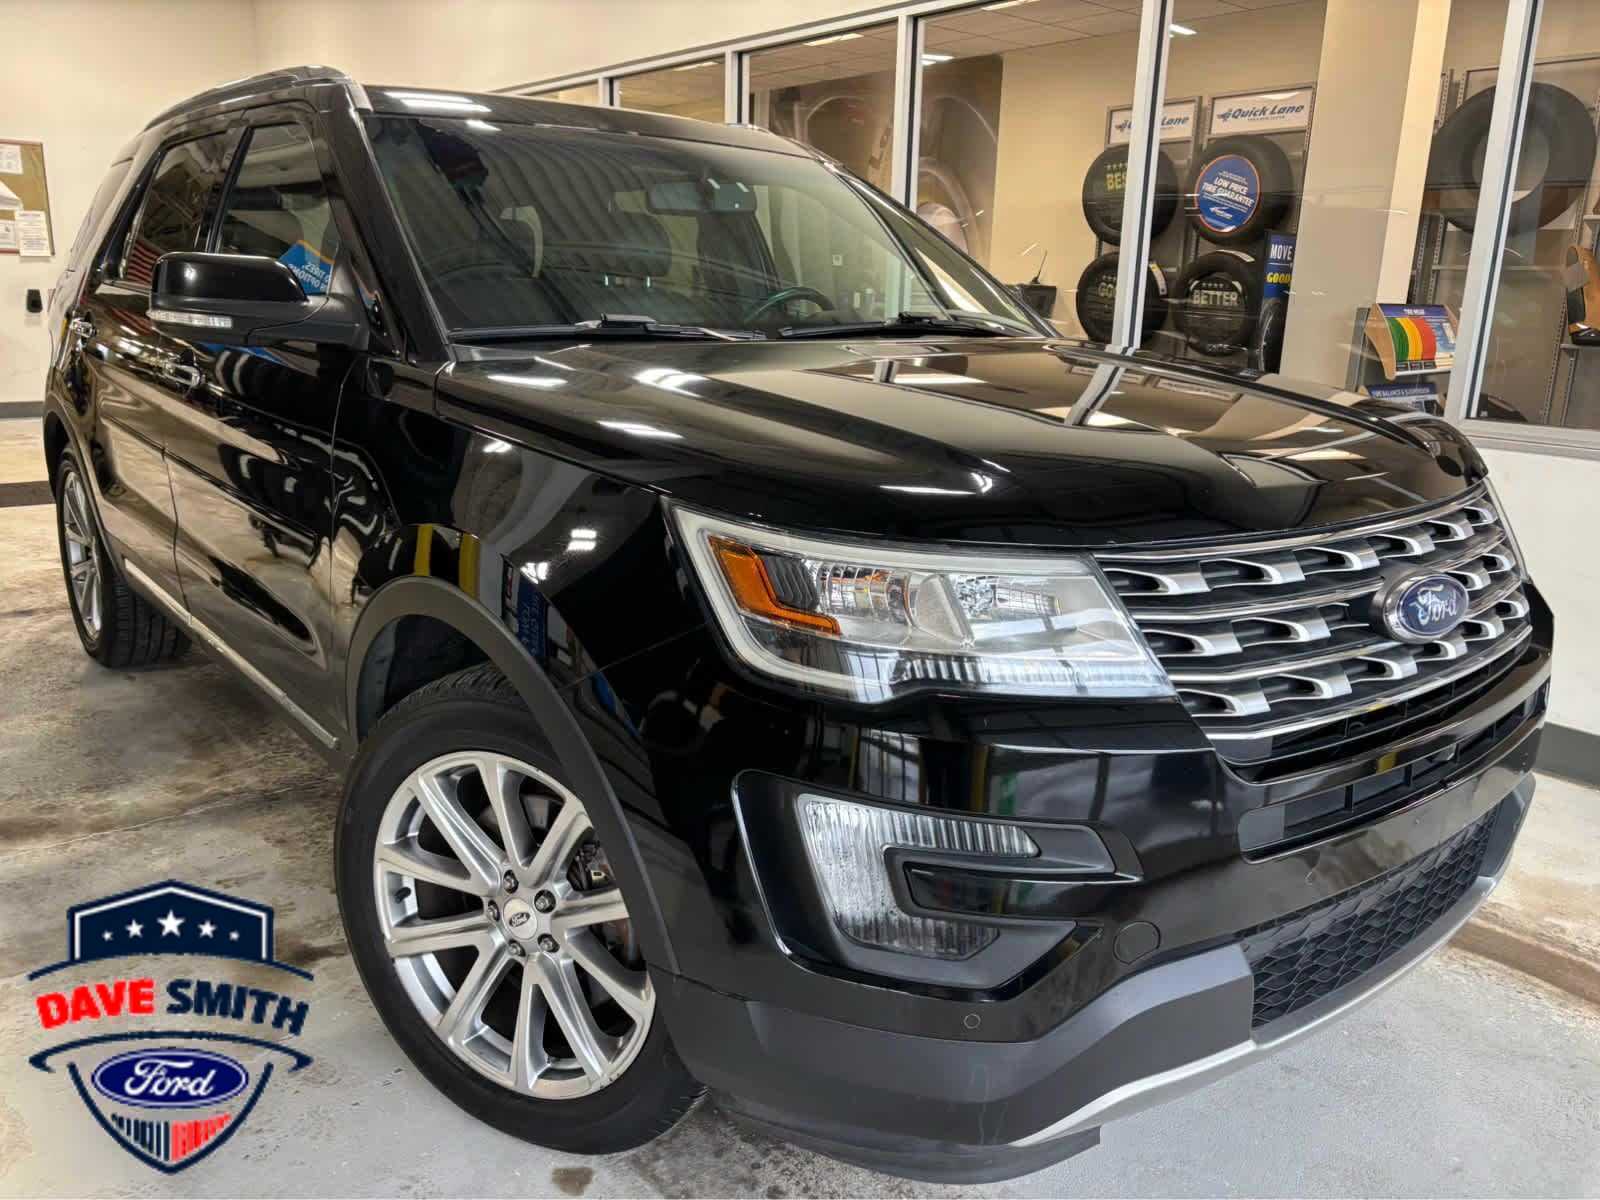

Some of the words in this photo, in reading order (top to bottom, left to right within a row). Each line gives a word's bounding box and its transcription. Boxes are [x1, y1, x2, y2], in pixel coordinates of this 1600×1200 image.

[1232, 106, 1269, 119] Quick
[1270, 104, 1304, 115] Lane
[1202, 182, 1218, 193] TIRE
[1217, 187, 1255, 207] GUARANTEE
[1214, 177, 1230, 188] LOW
[1229, 182, 1248, 195] PRICE
[1270, 244, 1292, 260] MOVE
[1192, 290, 1239, 305] BETTER
[1409, 584, 1457, 626] Ford
